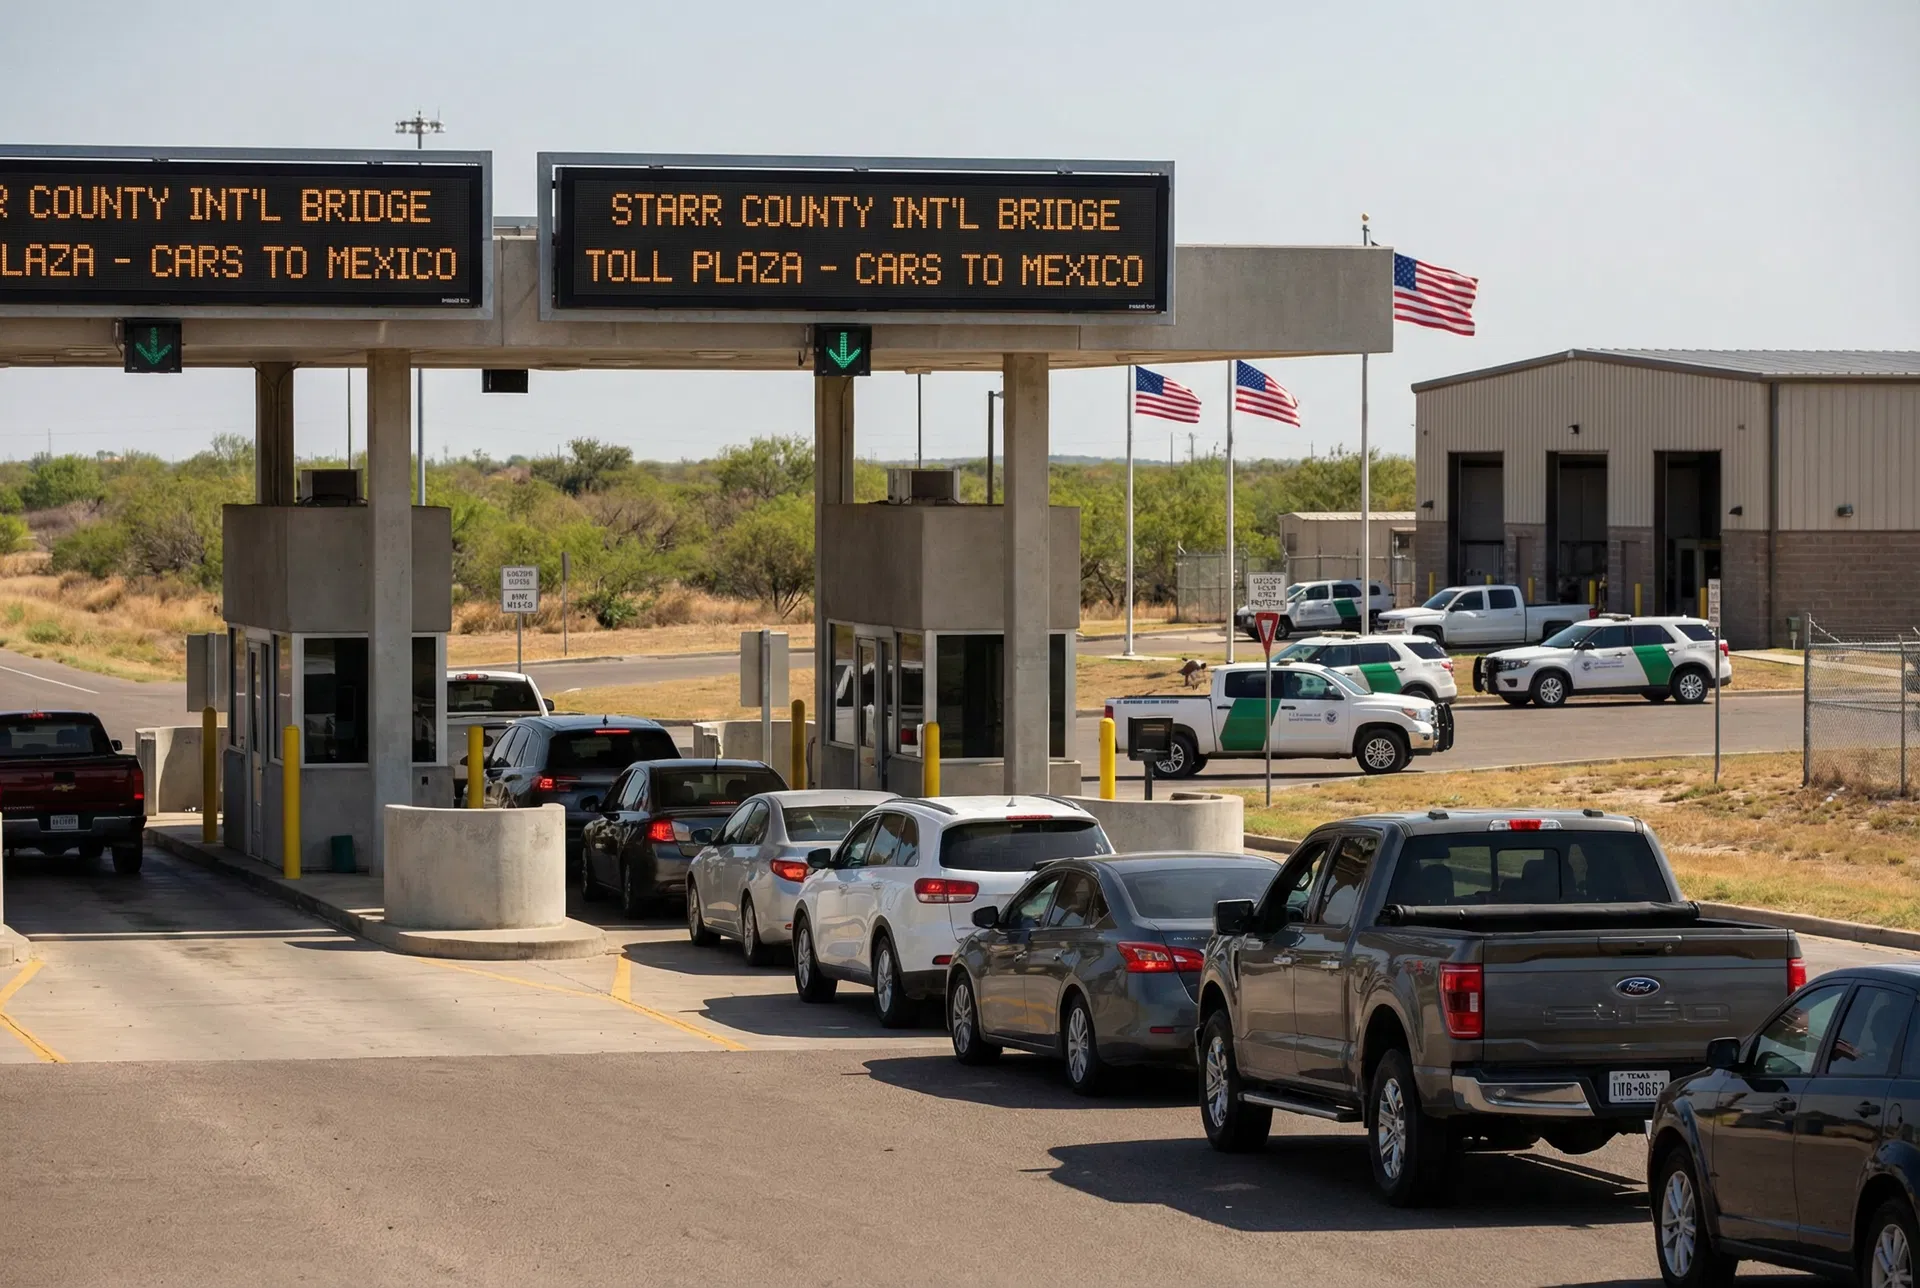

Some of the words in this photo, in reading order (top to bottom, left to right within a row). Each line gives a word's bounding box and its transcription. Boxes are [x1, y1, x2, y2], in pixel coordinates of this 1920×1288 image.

[29, 185, 169, 220] COUNTY
[190, 187, 281, 222] INT'L
[301, 188, 431, 223] BRIDGE
[611, 192, 722, 226] STARR
[741, 194, 873, 228] COUNTY
[892, 196, 979, 230] INT'L
[998, 198, 1120, 231] BRIDGE
[151, 244, 243, 278] CARS
[262, 245, 308, 279] TO
[328, 246, 457, 280] MEXICO
[585, 249, 673, 283] TOLL
[692, 250, 802, 284] PLAZA
[855, 252, 942, 285] CARS
[961, 253, 1003, 286] TO
[1021, 254, 1143, 287] MEXICO
[1626, 1073, 1651, 1082] TEXAS
